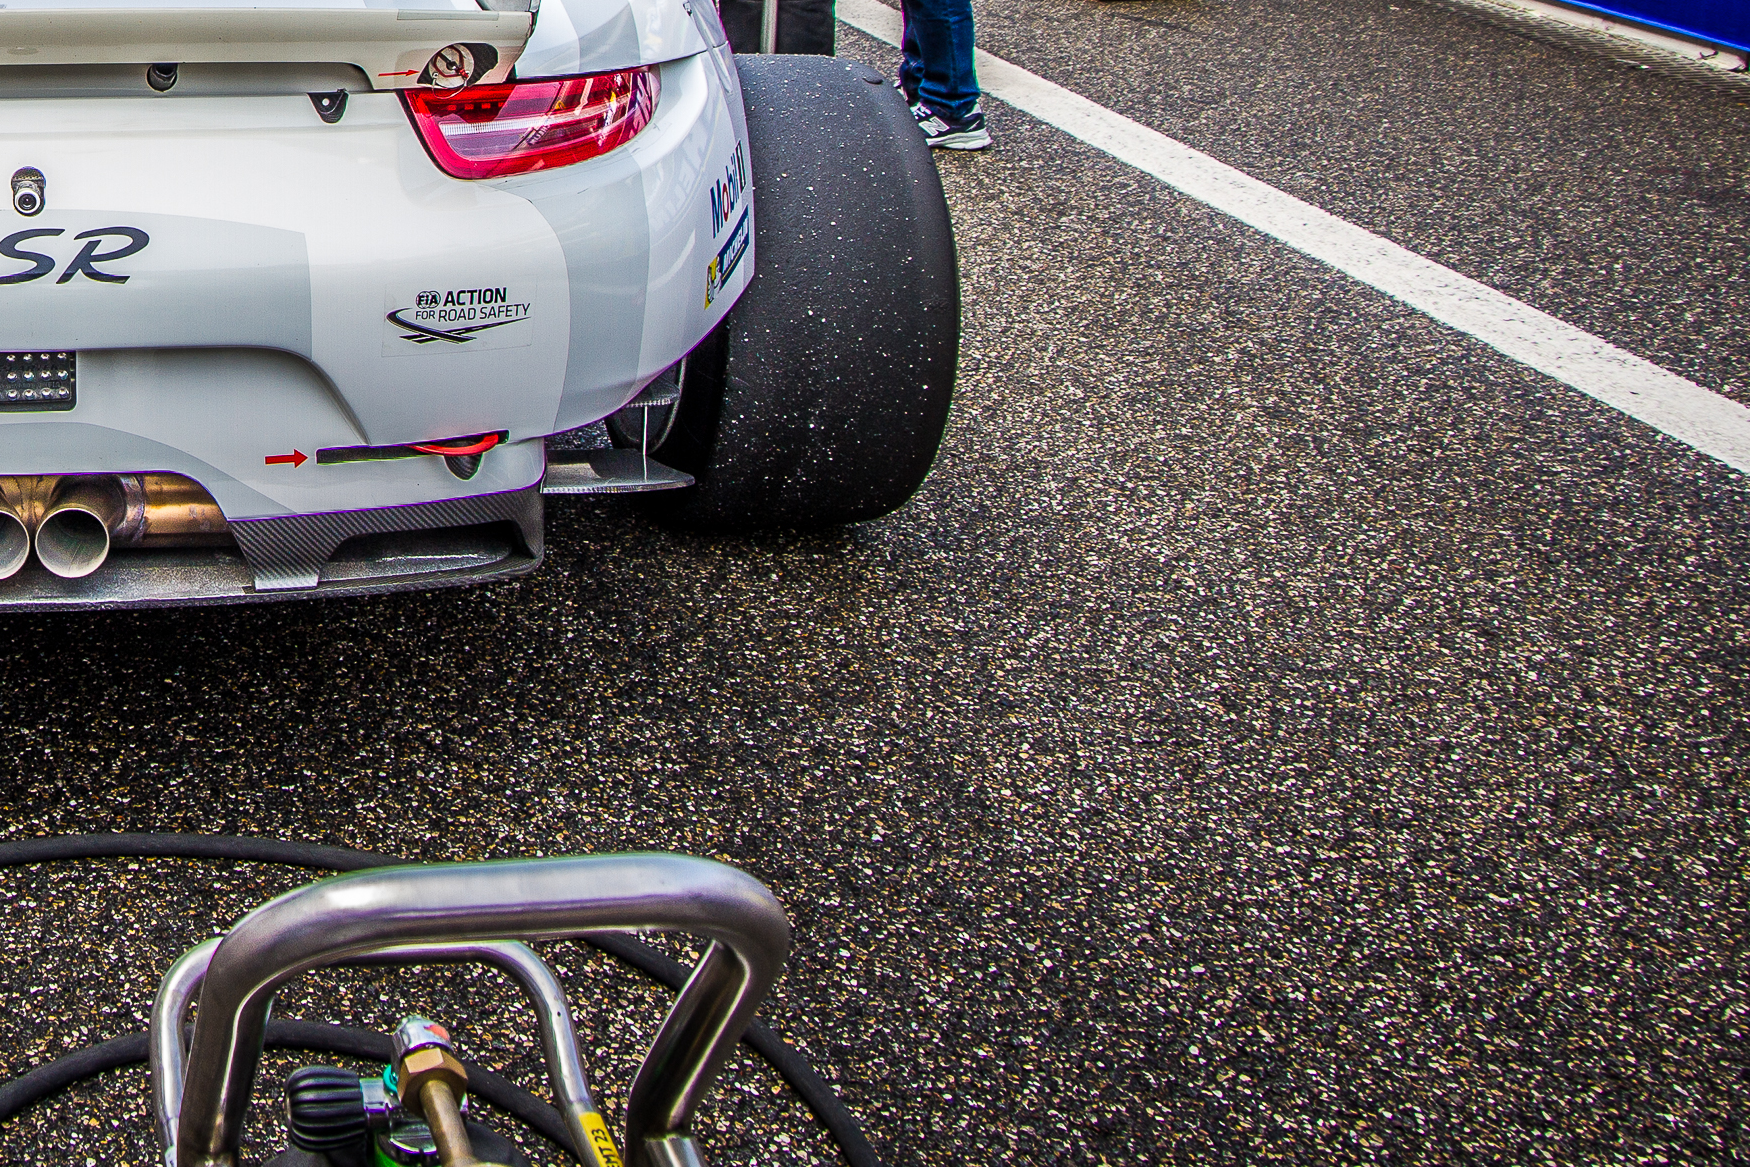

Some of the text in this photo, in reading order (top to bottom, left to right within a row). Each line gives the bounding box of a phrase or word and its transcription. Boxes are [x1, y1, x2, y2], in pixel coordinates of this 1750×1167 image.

[709, 153, 740, 240] Mobil
[416, 287, 507, 308] FIA ACTION
[415, 303, 531, 322] FOR ROAD SAFETY
